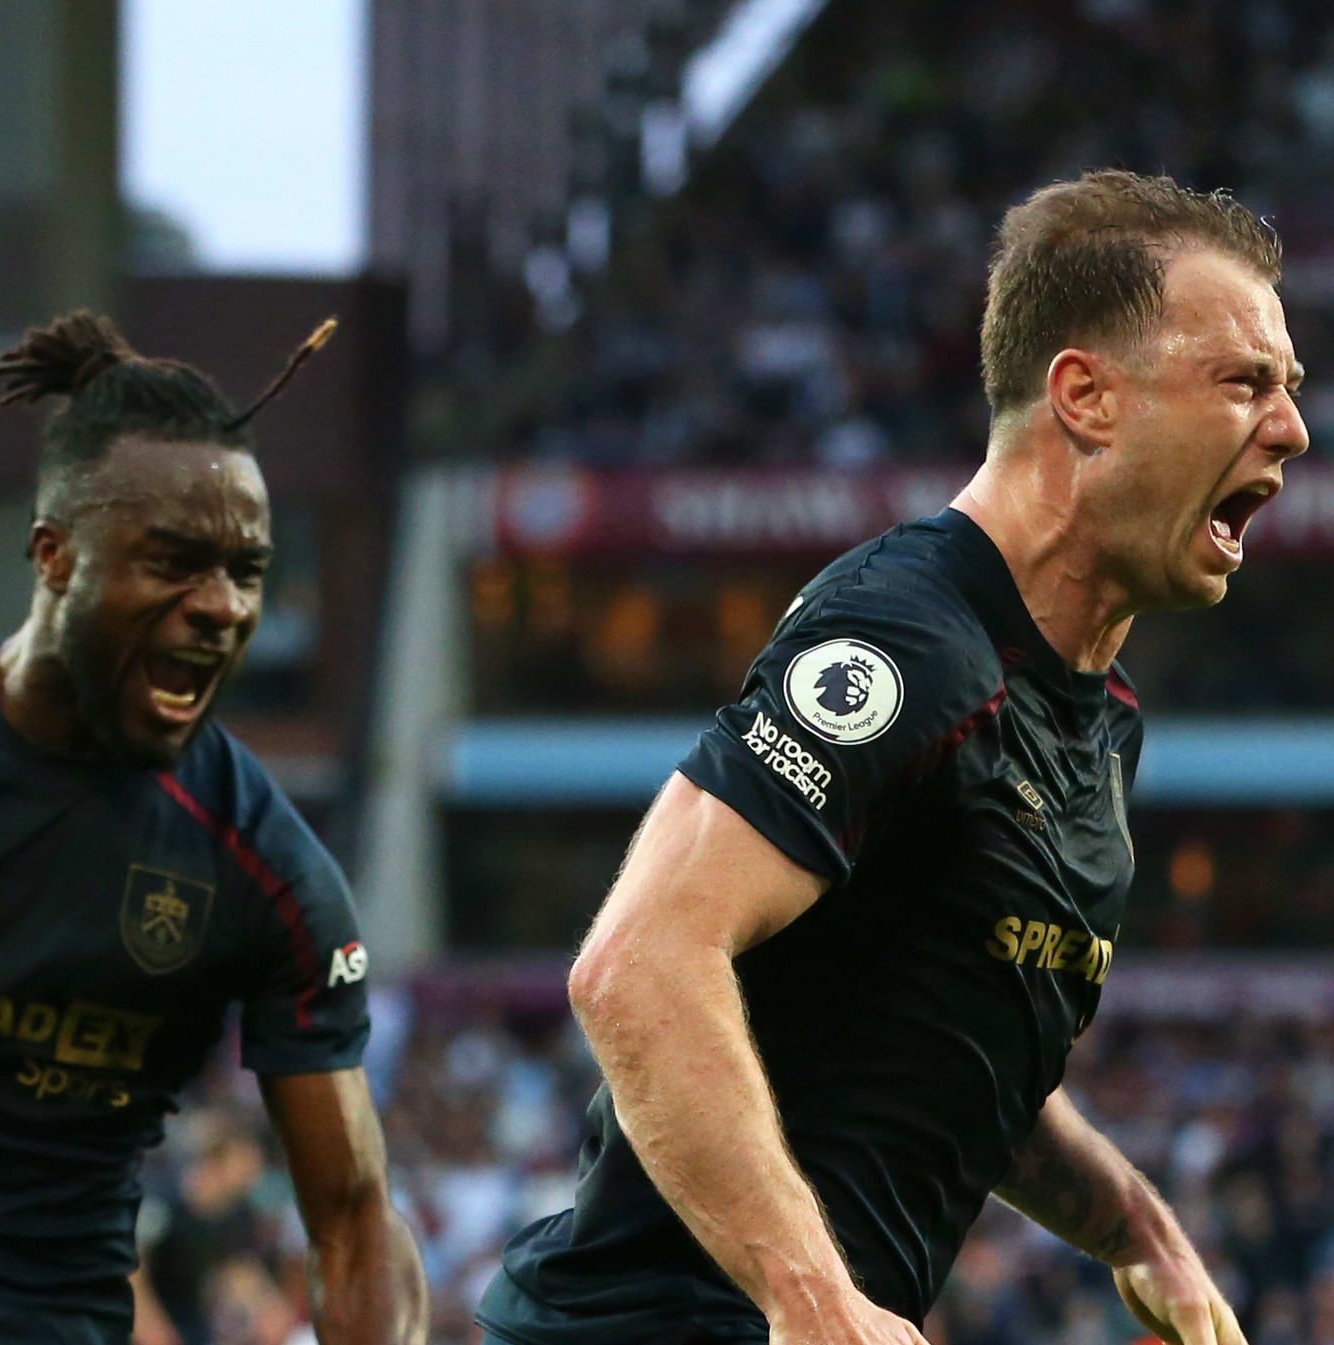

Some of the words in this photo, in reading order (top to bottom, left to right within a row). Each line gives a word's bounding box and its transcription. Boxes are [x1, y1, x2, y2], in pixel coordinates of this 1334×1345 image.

[812, 712, 847, 731] Premier
[848, 710, 878, 731] League
[752, 711, 779, 743] No
[776, 734, 832, 788] room
[764, 750, 827, 810] racism
[16, 1058, 131, 1108] Spors
